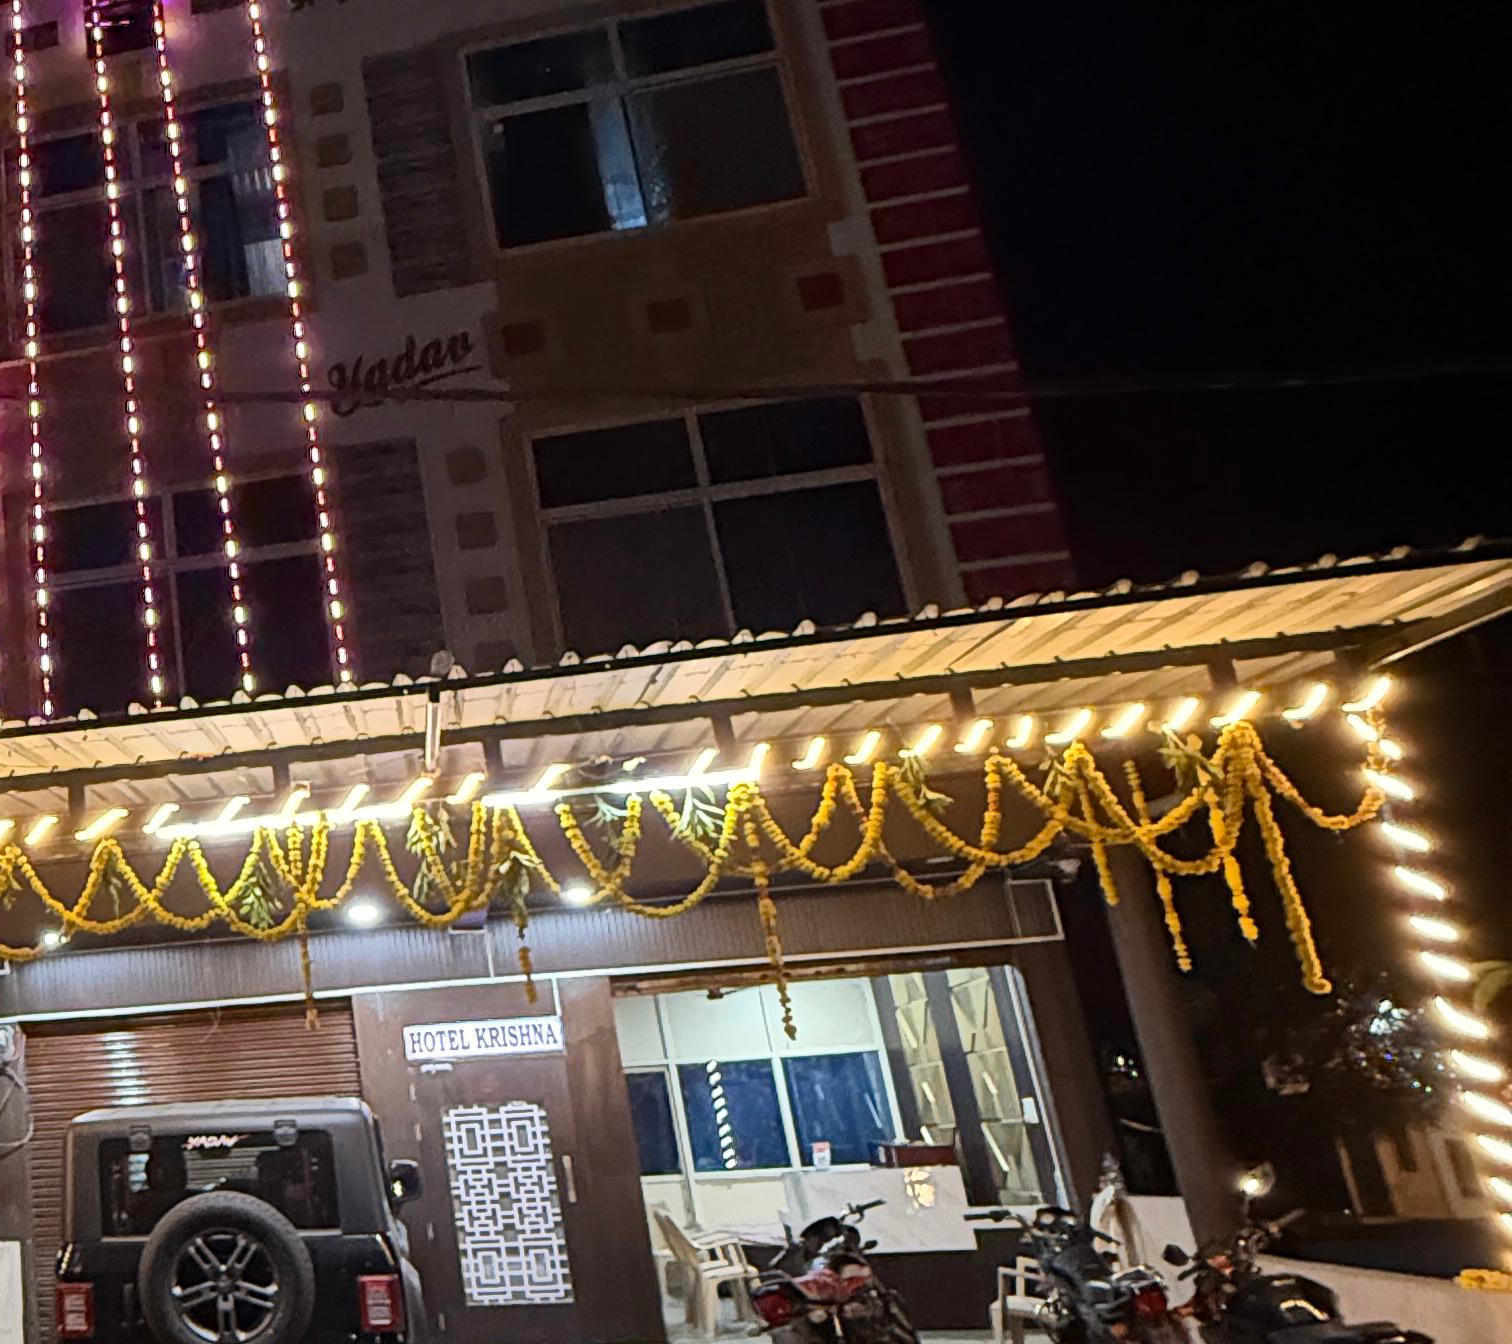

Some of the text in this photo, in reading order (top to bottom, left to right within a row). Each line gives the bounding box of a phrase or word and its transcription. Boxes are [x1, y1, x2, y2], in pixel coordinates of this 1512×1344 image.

[327, 331, 476, 417] Yadav
[409, 1022, 559, 1054] HOTEL KRISHNA
